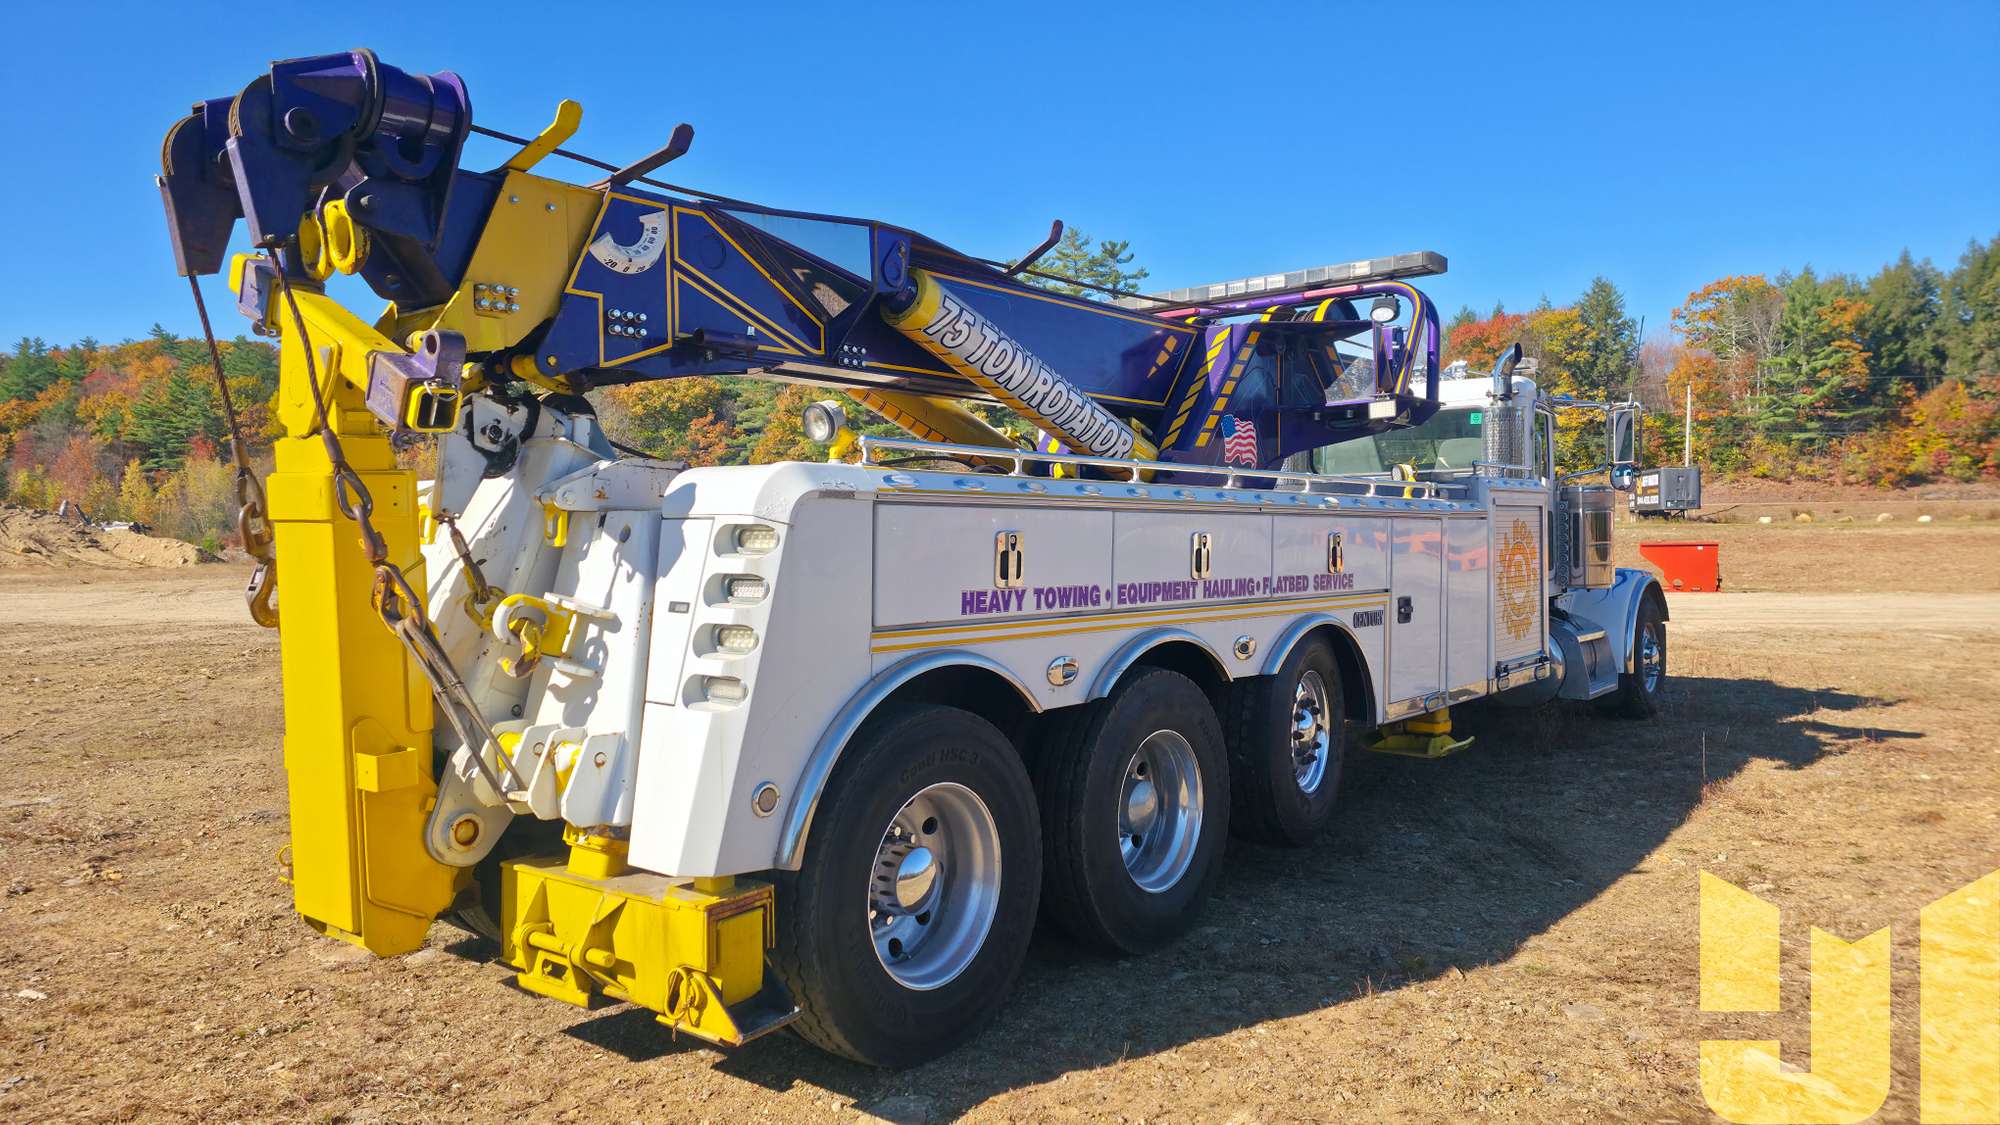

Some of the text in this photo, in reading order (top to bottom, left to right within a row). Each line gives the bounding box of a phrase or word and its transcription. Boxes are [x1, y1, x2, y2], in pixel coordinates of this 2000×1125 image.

[923, 294, 1135, 460] 75 TON ROTATOR
[961, 588, 1027, 615] HEAVY
[1033, 585, 1101, 610] TOWING
[1117, 581, 1199, 605] EQUIPMENT
[1203, 578, 1256, 599] HAULING
[1313, 573, 1354, 592] SERVICE
[1353, 610, 1384, 629] CENTURY
